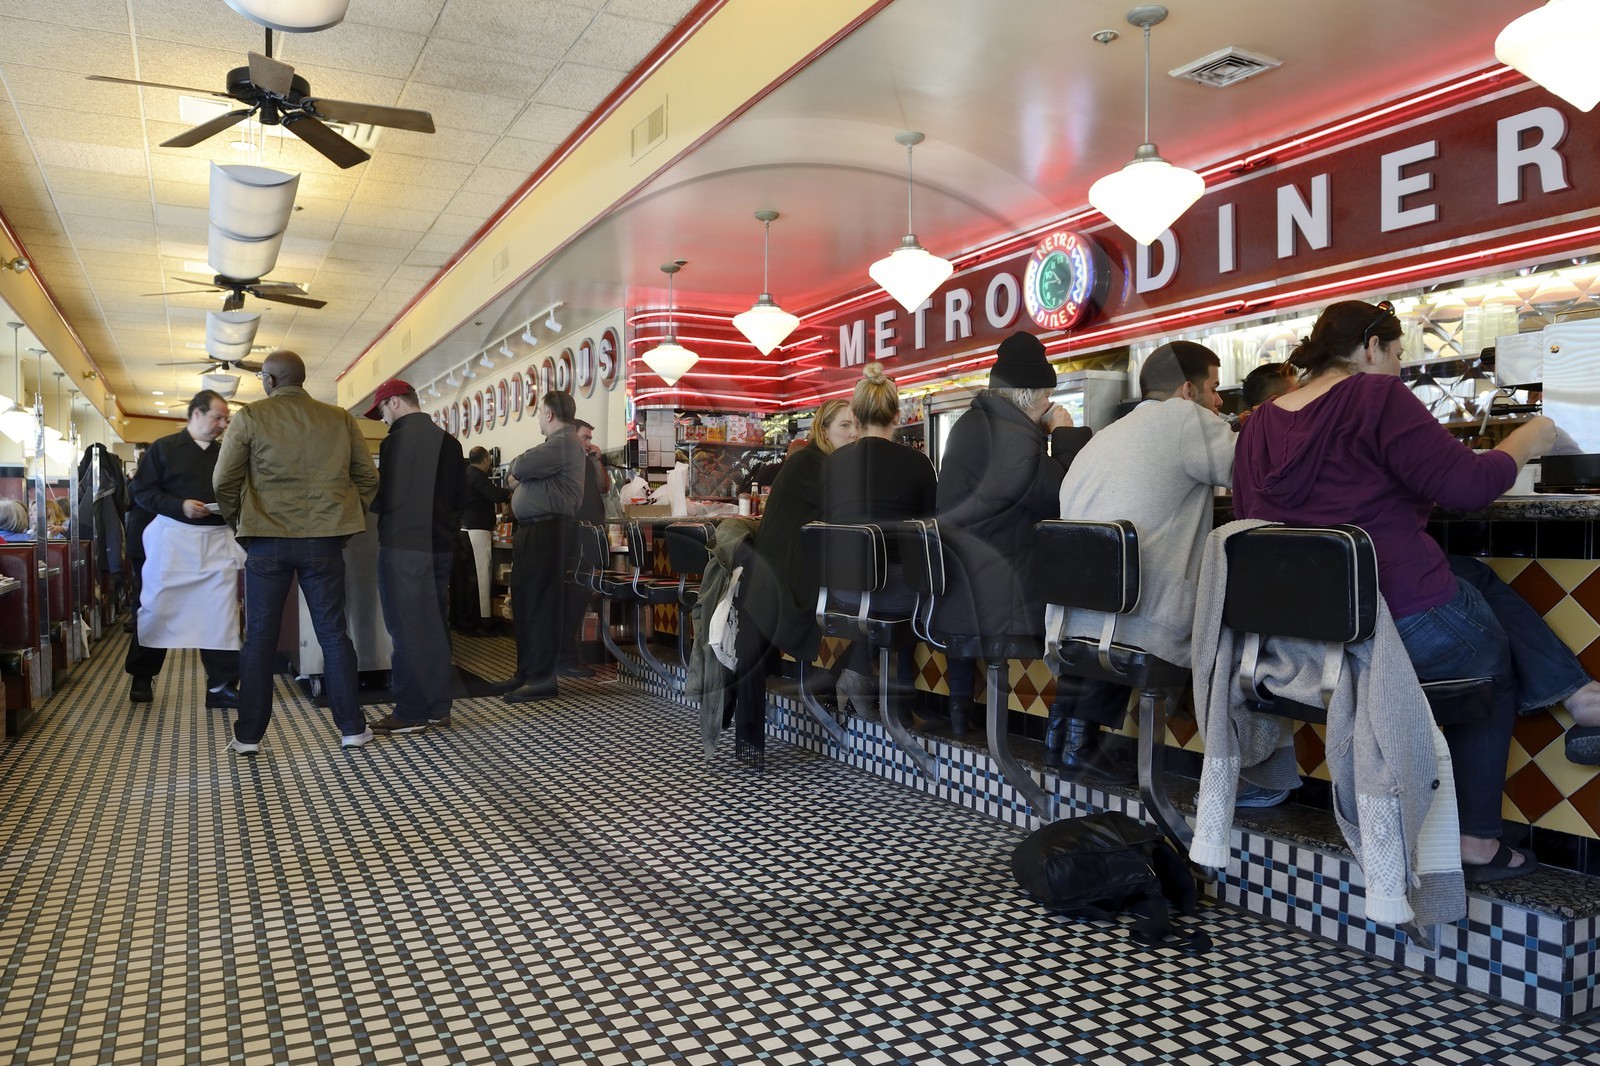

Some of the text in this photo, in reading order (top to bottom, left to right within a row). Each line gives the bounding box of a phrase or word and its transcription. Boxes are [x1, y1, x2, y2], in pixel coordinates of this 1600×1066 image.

[839, 106, 1571, 368] METRO DINER
[1036, 301, 1077, 328] DINER
[472, 338, 614, 426] DELICIOUS
